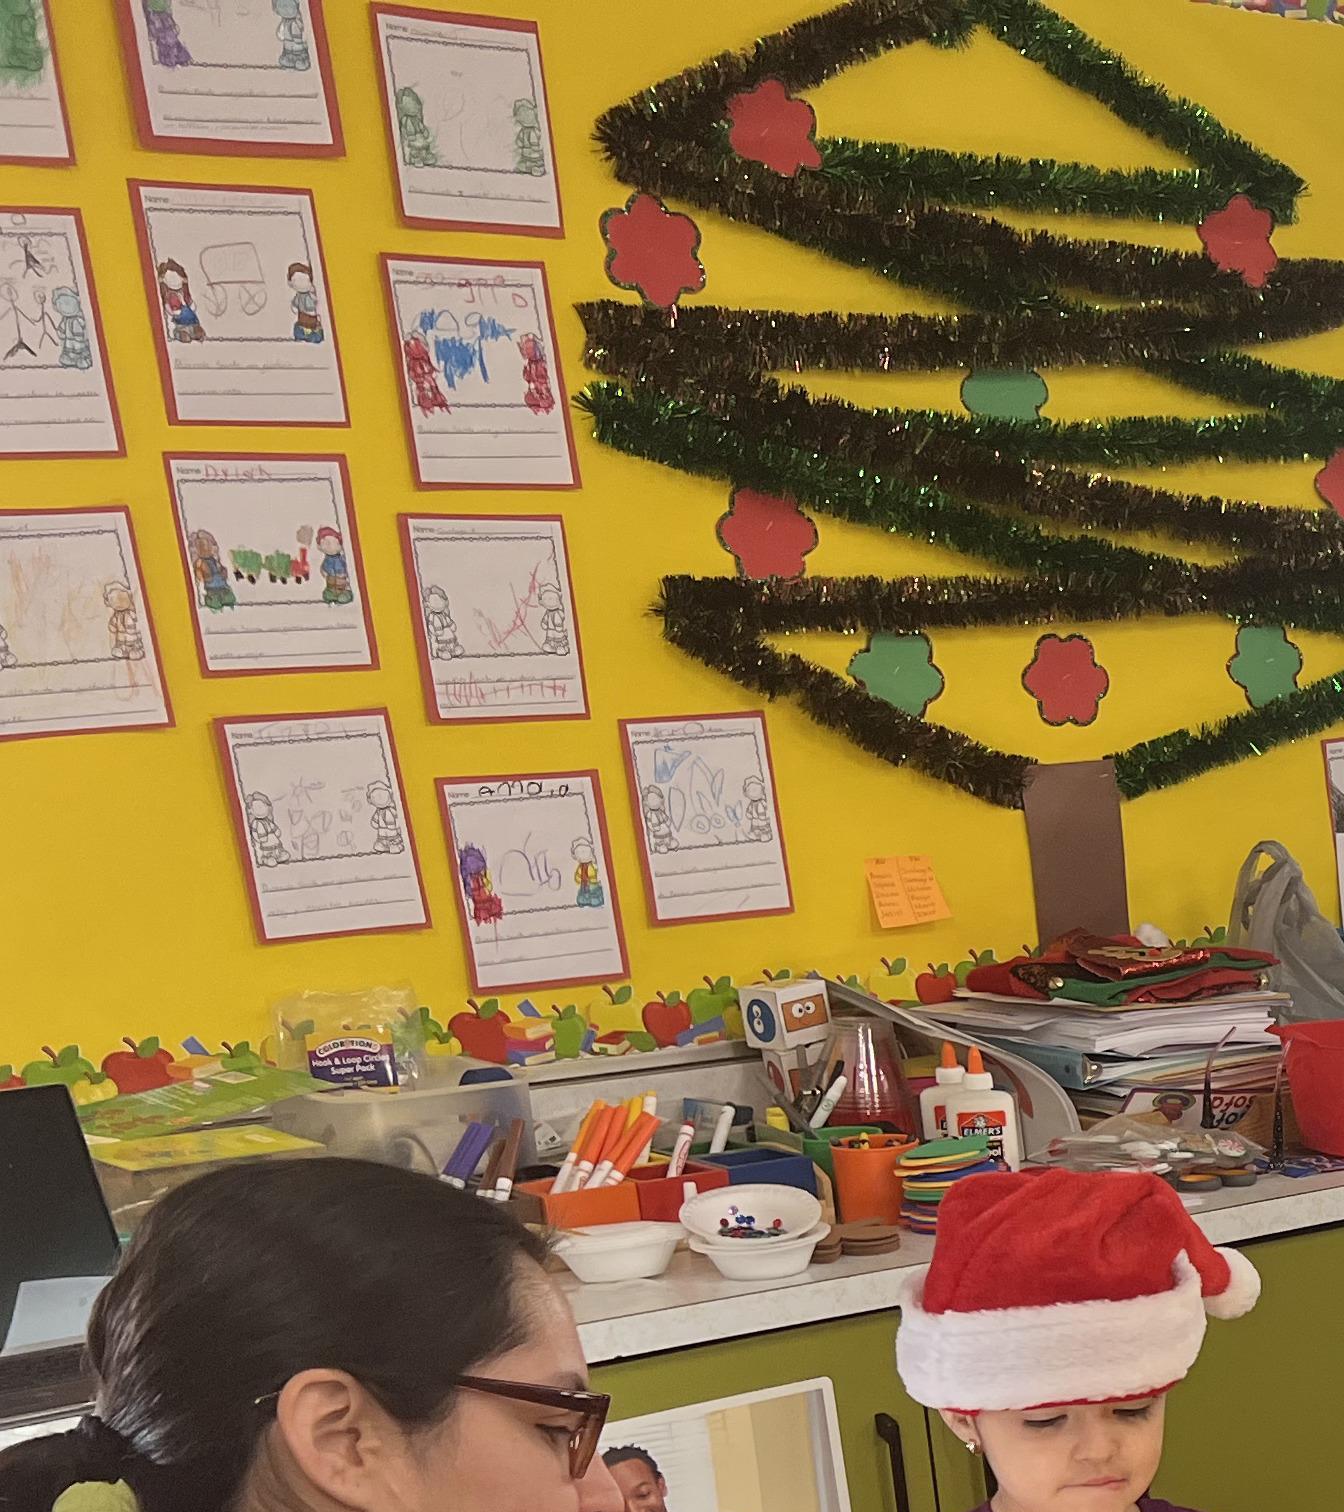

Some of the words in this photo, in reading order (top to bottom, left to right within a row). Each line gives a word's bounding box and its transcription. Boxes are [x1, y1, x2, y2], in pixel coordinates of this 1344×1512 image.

[177, 465, 201, 475] Name
[449, 790, 470, 800] Name
[312, 1056, 333, 1067] Hook
[333, 1056, 341, 1065] &
[342, 1056, 362, 1066] Loop
[330, 1065, 355, 1075] Super
[356, 1063, 376, 1072] Pack
